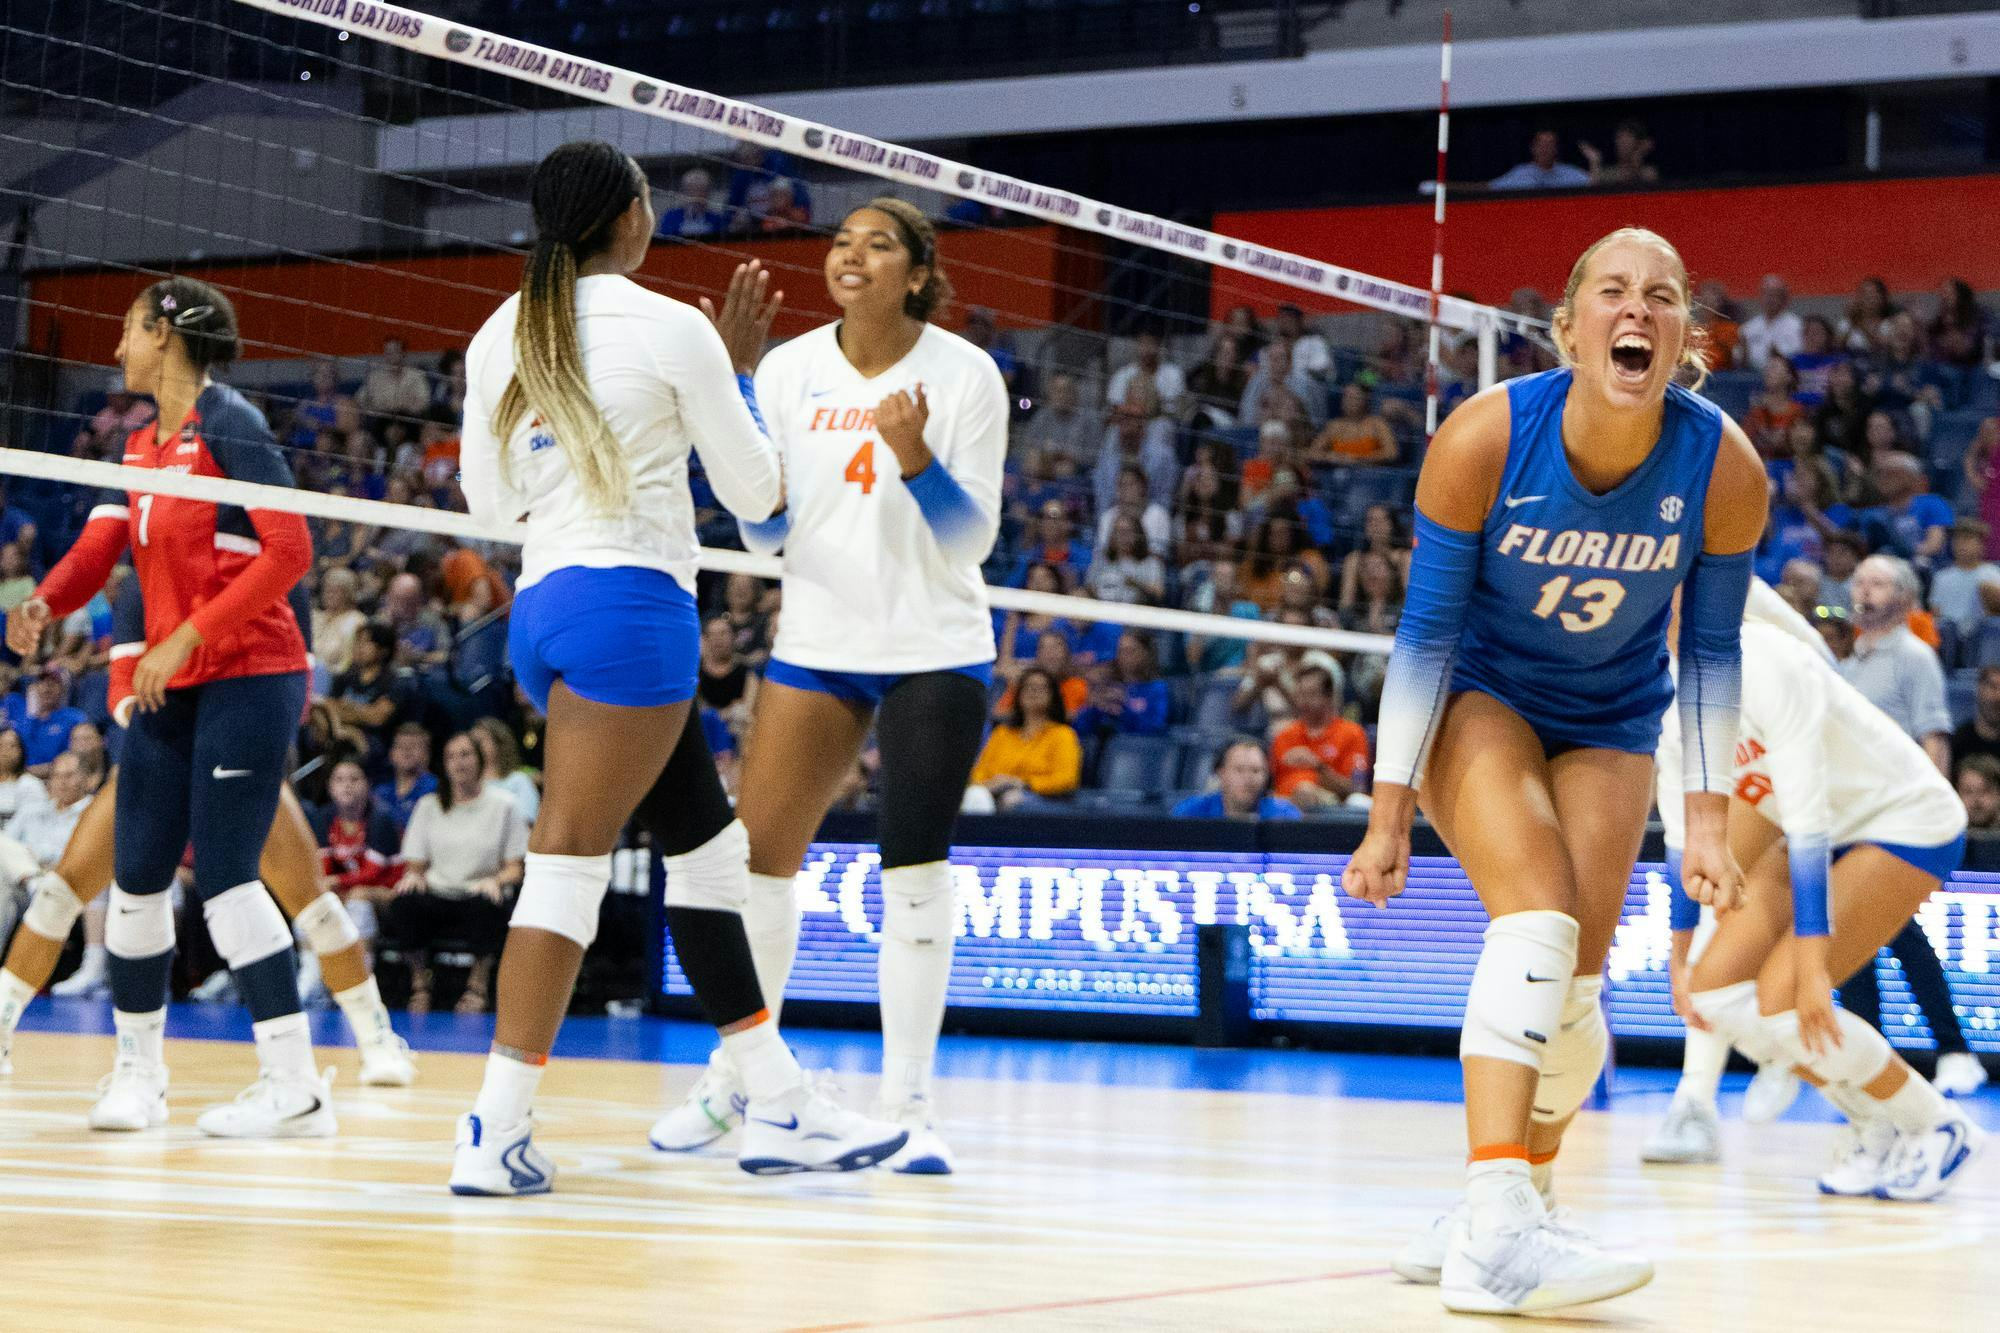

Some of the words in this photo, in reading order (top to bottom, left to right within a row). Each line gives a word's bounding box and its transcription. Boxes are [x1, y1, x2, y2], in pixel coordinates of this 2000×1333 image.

[351, 1, 423, 39] GATORS
[474, 37, 548, 74] FLORIDA
[549, 58, 613, 92] GATORS
[659, 89, 725, 121] FLORIDA
[728, 106, 785, 137] GATORS
[809, 407, 878, 431] FLOR
[844, 440, 877, 494] 4
[1497, 523, 1680, 572] FLORIDA
[1531, 575, 1626, 632] 13
